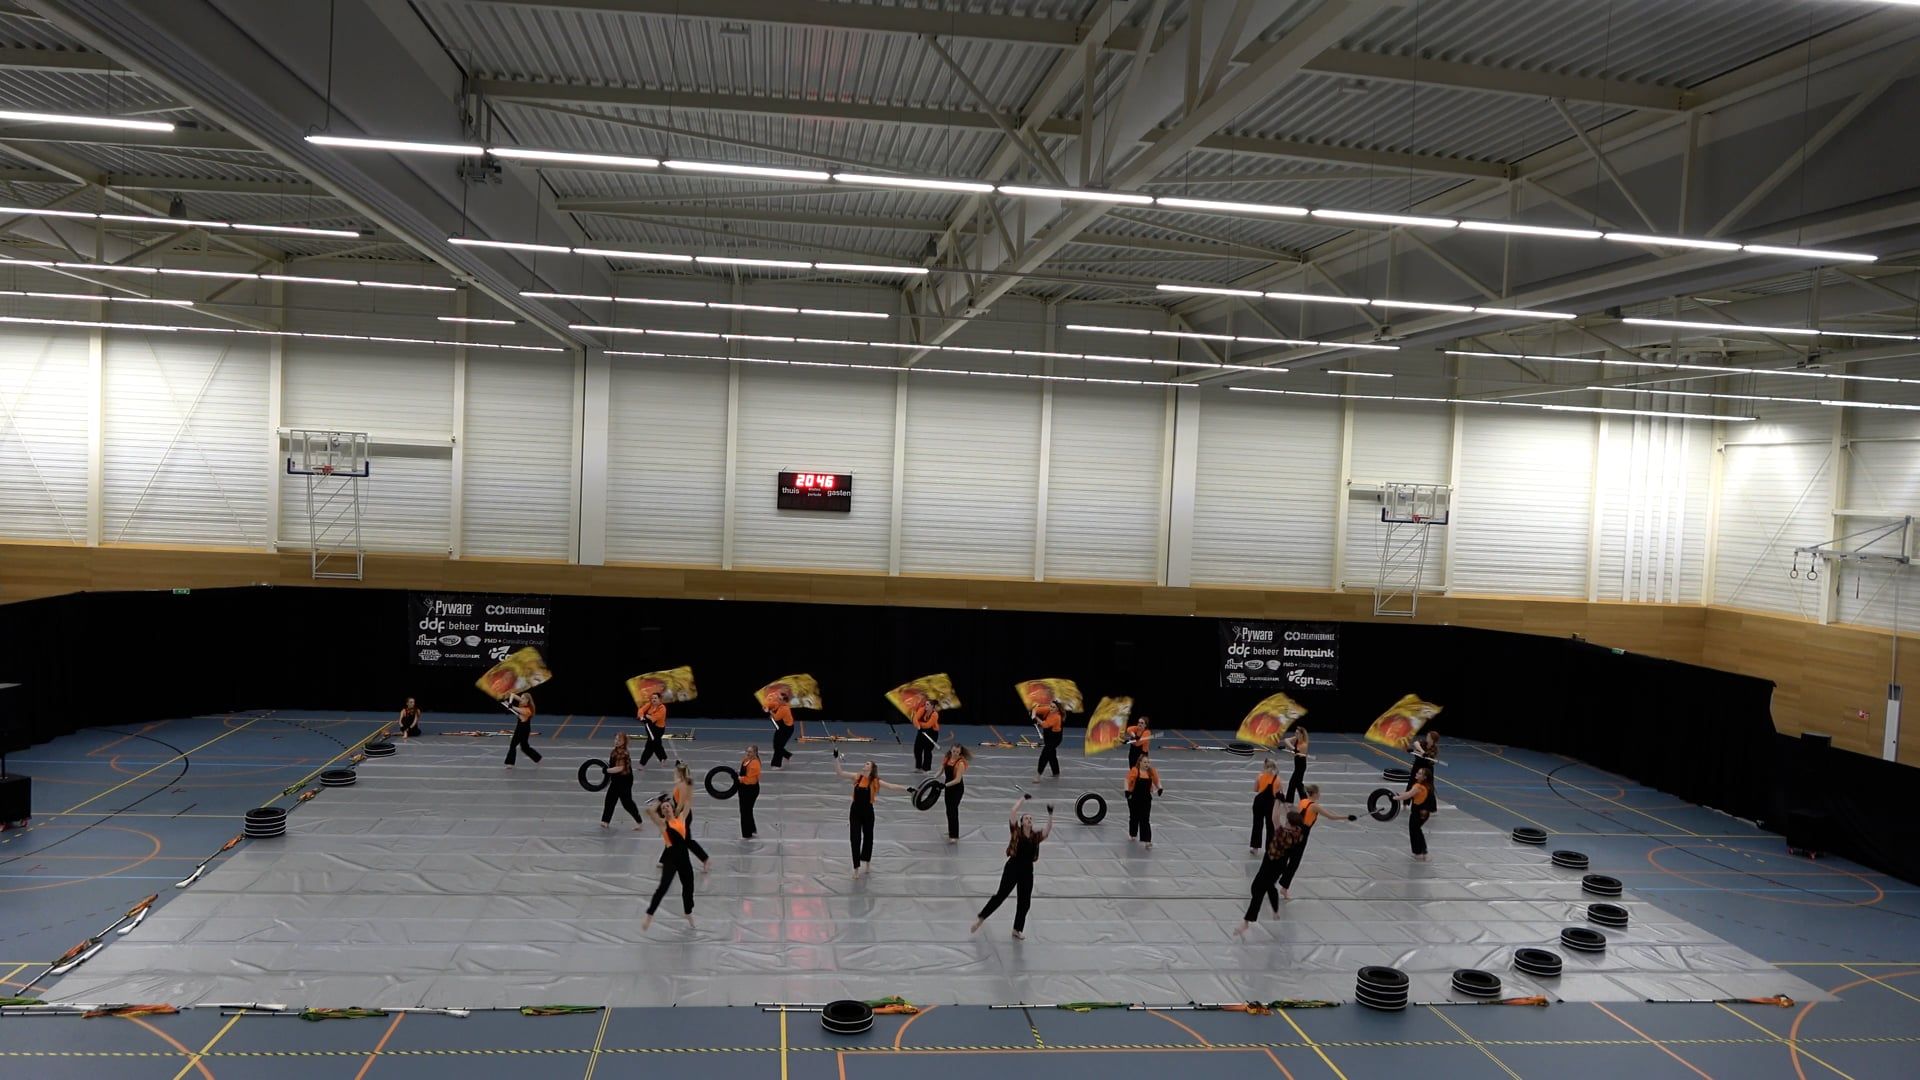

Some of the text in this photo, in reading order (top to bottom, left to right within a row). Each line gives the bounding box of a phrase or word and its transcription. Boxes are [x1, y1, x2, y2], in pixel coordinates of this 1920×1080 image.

[435, 600, 472, 616] Pyware
[419, 617, 480, 633] ddf beheer
[484, 622, 545, 635] brainpink
[1242, 627, 1273, 642] Pyware
[1228, 642, 1279, 658] ddf beheer
[1284, 647, 1334, 659] brainpink
[1295, 676, 1314, 687] cgn
